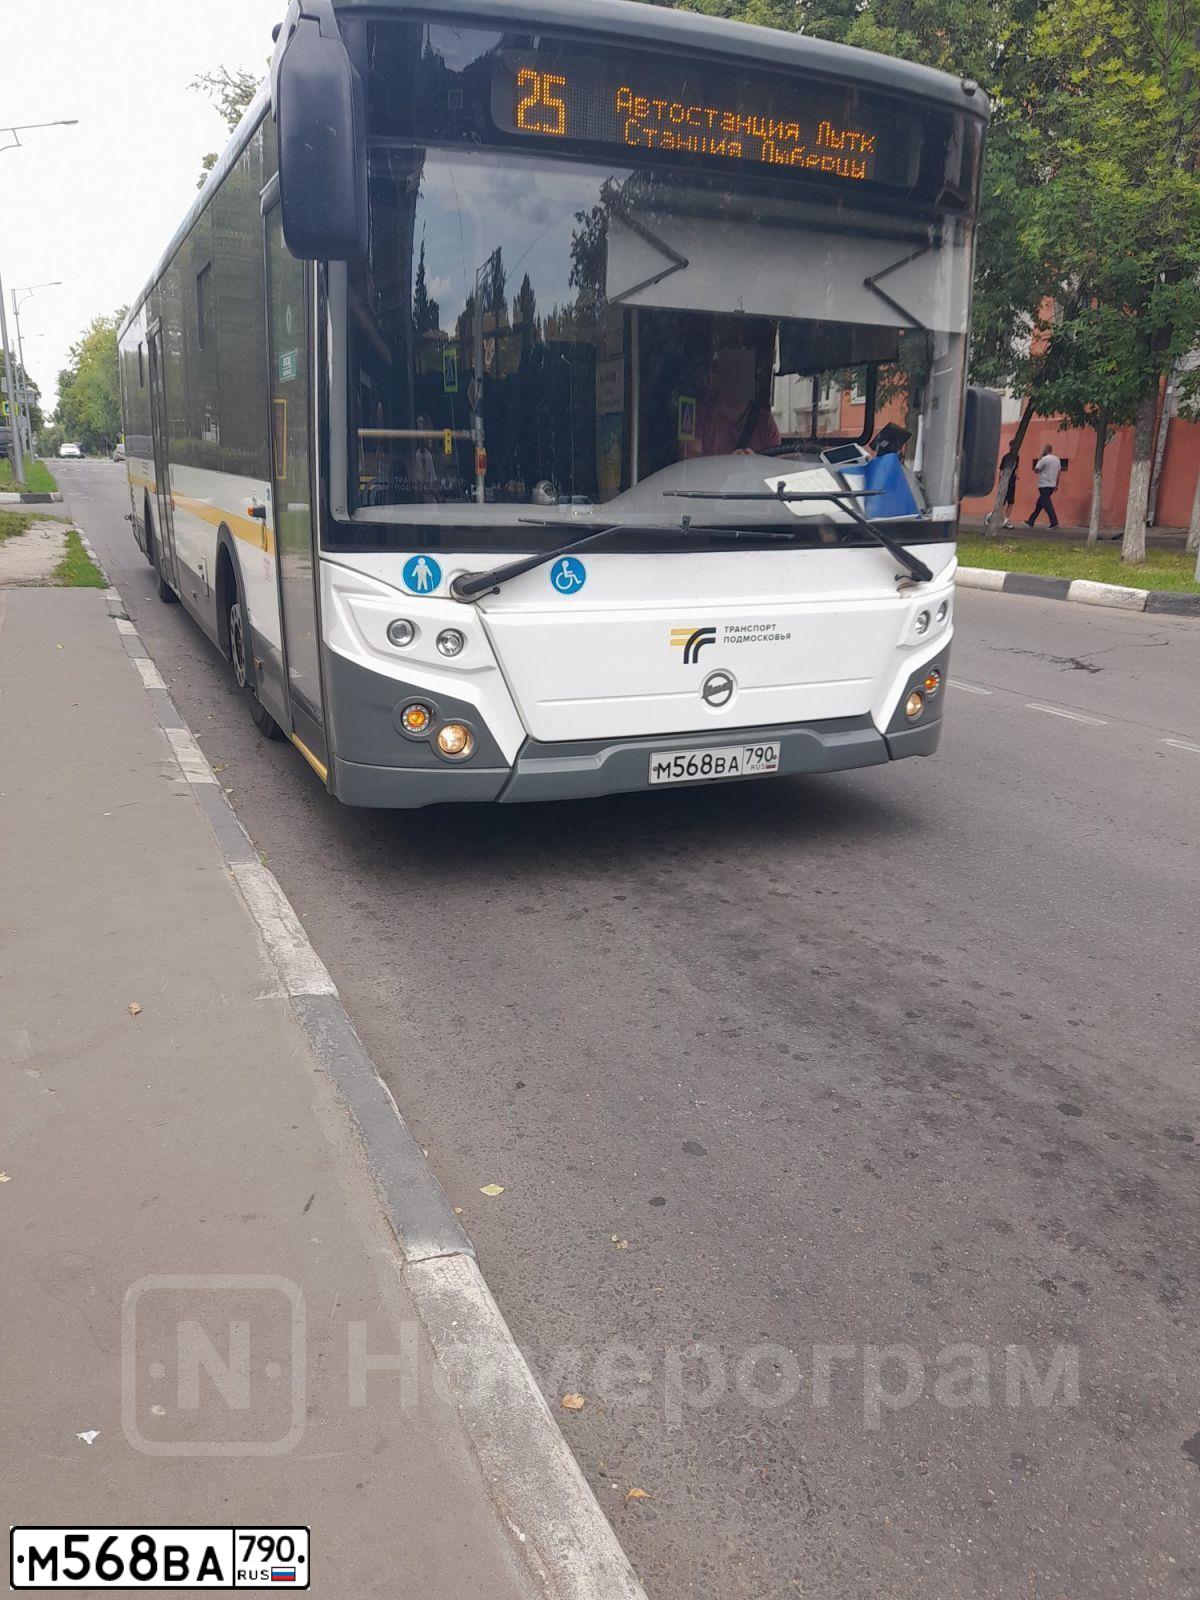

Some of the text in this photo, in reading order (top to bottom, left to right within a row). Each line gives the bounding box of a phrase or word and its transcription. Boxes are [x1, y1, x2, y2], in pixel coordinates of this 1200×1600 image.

[516, 68, 567, 135] 25
[615, 86, 800, 142] Автостанция
[723, 633, 792, 644] ПОДМОСКОВЬЯ
[724, 624, 777, 633] ТРАНСПОРТ
[656, 746, 774, 779] М568ВА 790
[750, 763, 766, 771] RUS
